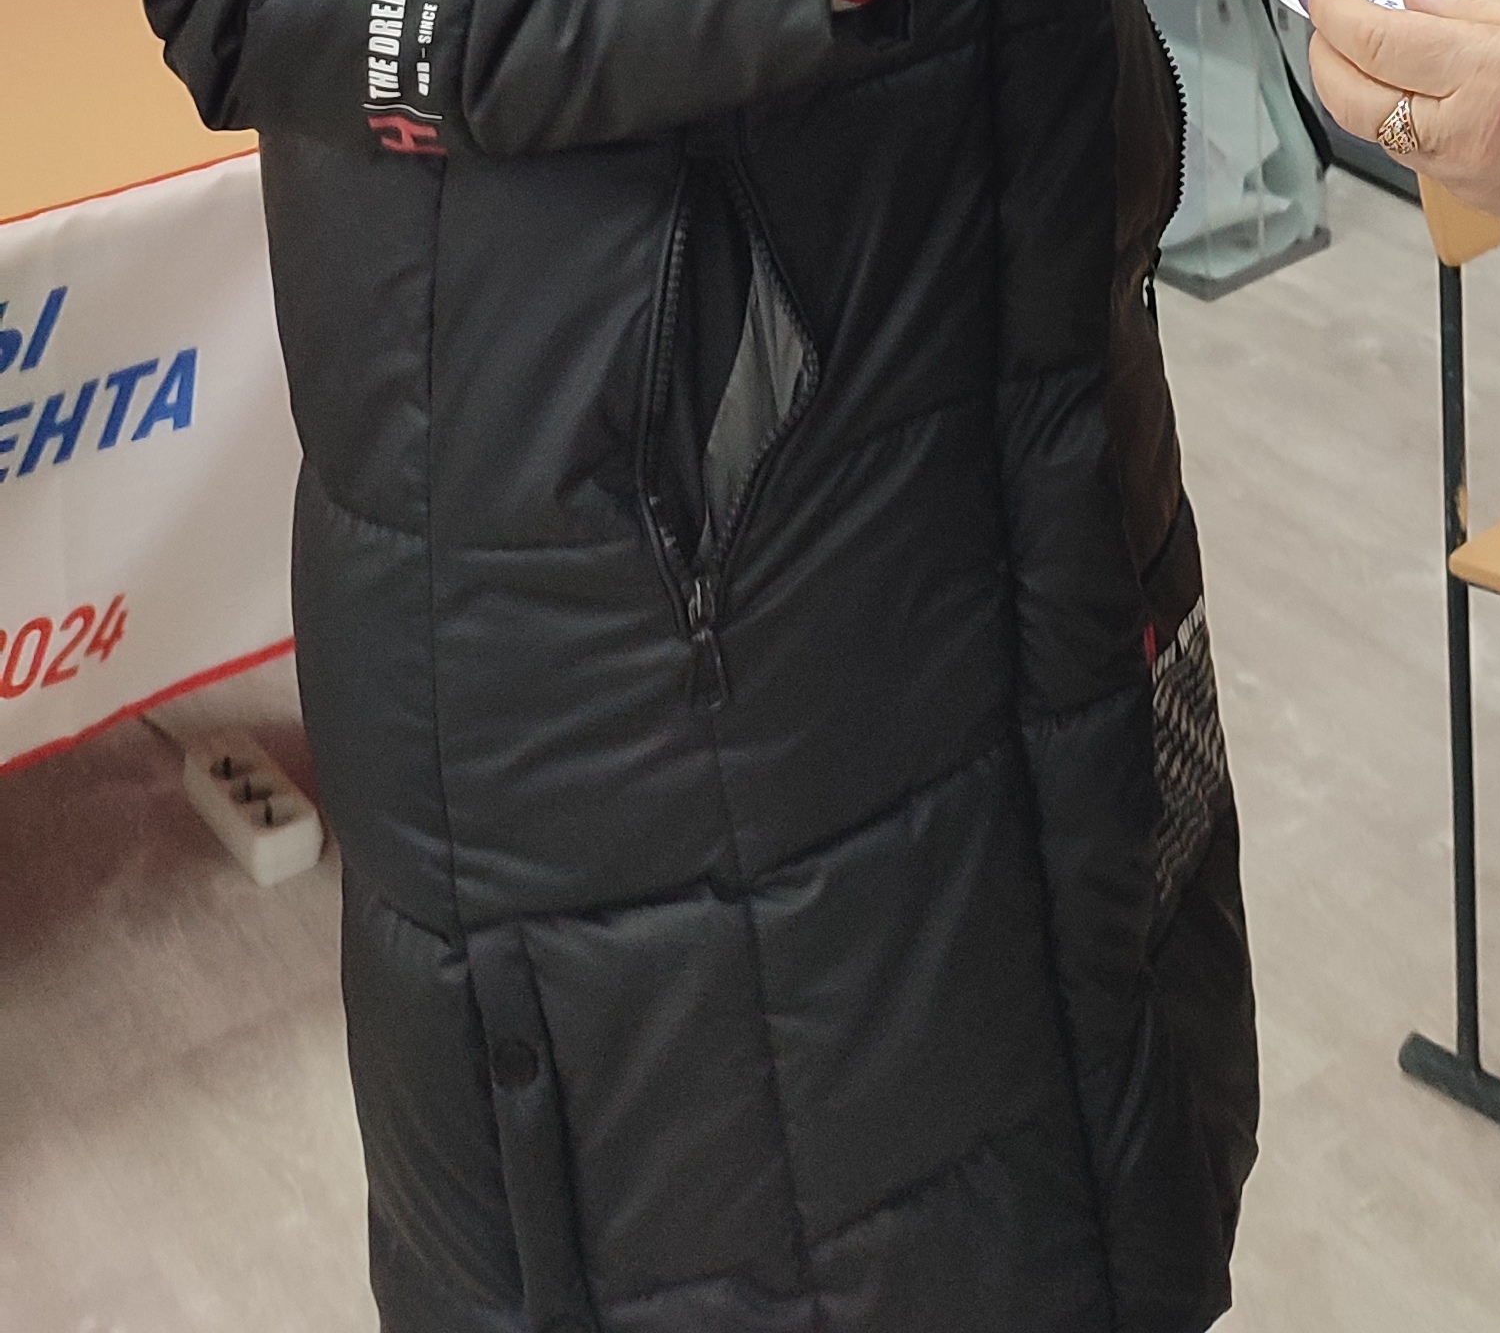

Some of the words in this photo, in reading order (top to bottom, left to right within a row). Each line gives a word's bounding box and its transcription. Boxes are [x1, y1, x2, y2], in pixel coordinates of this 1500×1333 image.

[418, 3, 438, 44] SINCE
[369, 56, 401, 99] THE
[0, 593, 128, 700] 024
